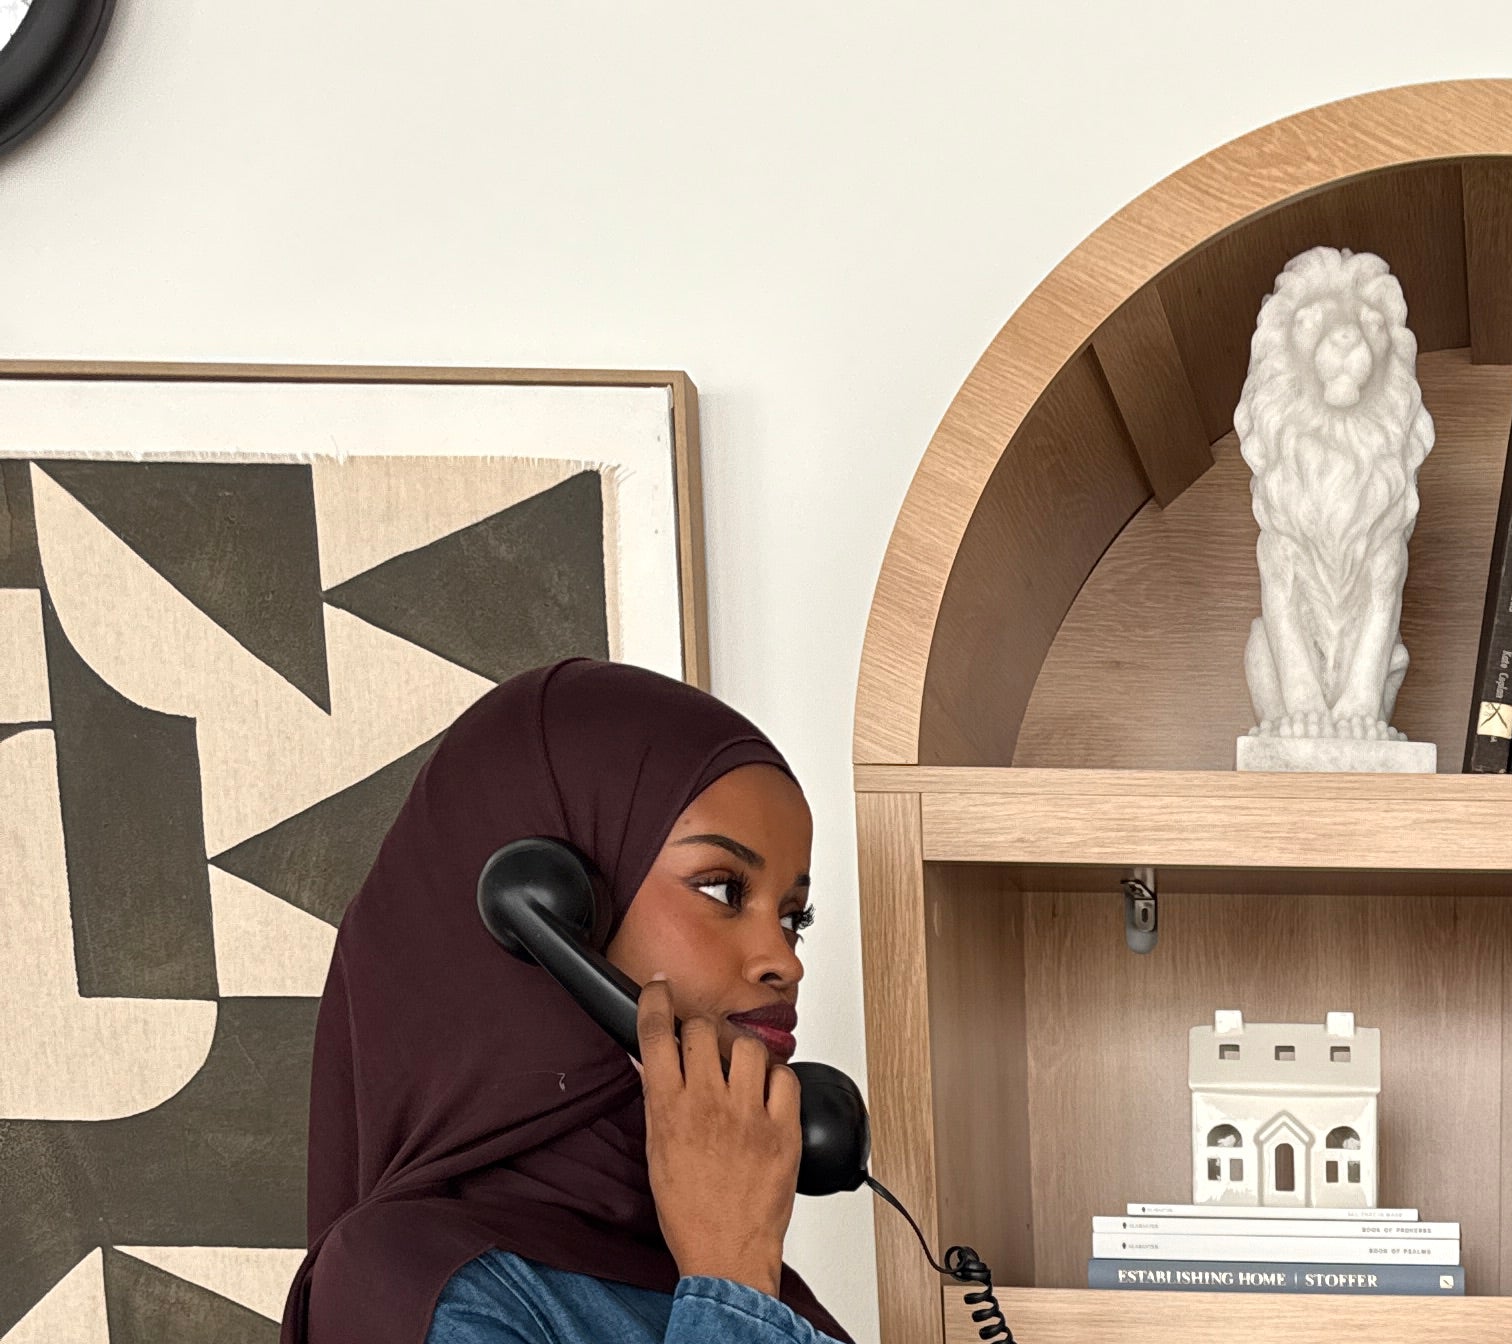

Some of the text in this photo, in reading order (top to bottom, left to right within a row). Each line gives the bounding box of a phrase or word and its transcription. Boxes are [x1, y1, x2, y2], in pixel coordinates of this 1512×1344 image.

[1118, 1269, 1378, 1288] ESTABLISHING HOME STOFFER
